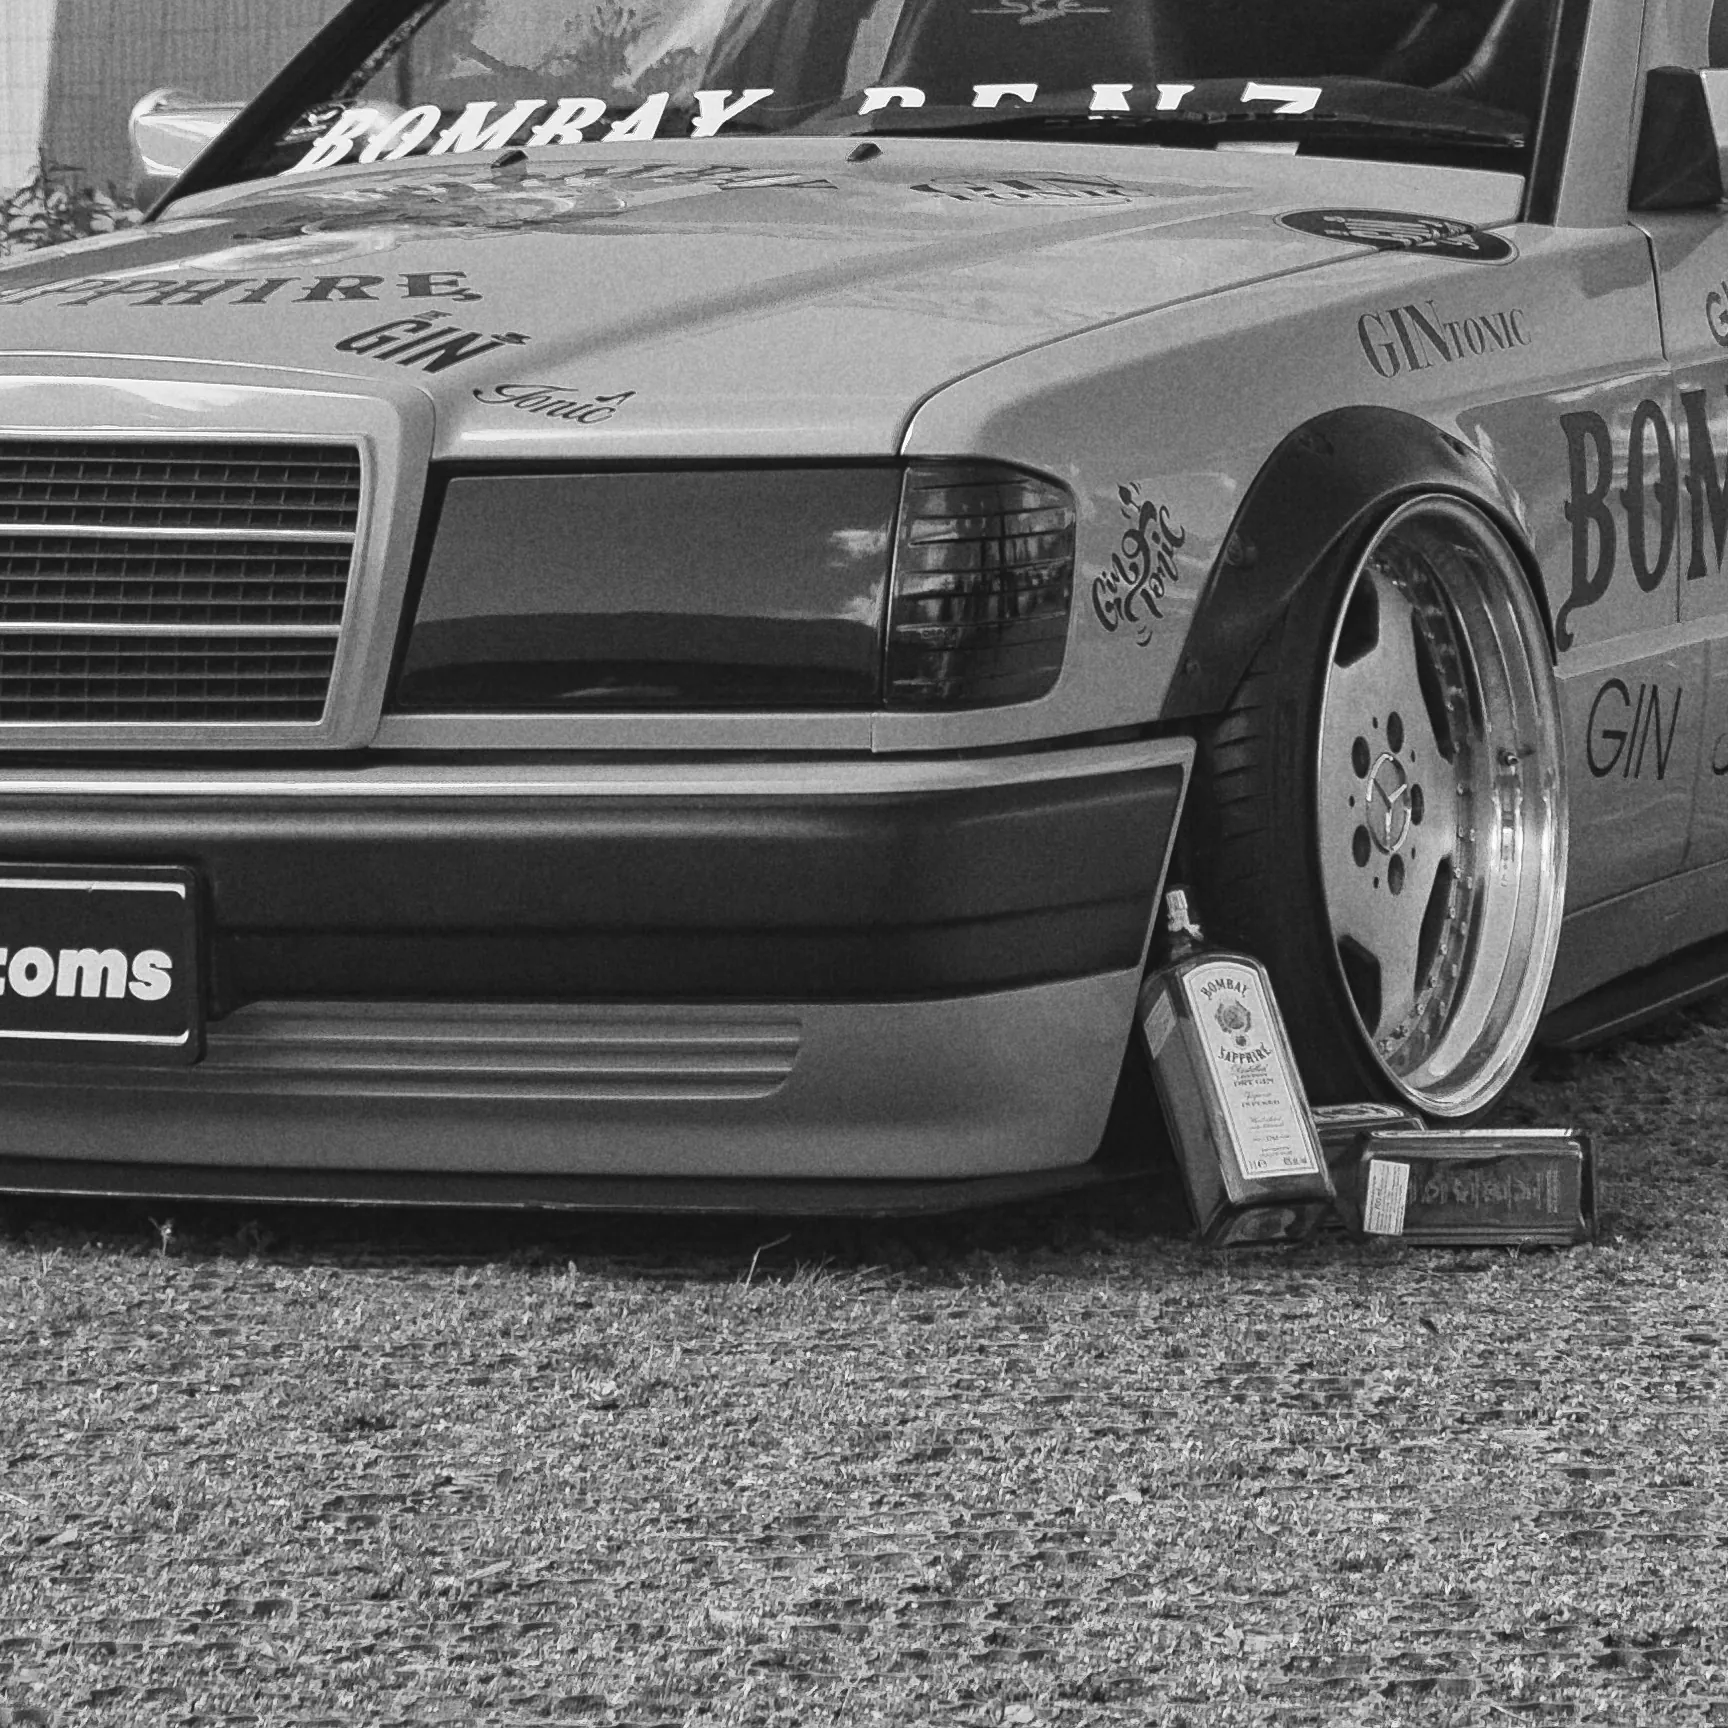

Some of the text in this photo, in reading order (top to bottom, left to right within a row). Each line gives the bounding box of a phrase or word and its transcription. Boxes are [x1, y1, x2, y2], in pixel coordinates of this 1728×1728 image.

[334, 318, 506, 373] GIN
[472, 383, 636, 424] Tonic
[1586, 677, 1683, 780] GIN
[1200, 977, 1252, 1001] BOMBAY
[1217, 1041, 1272, 1065] SAPPHIRE
